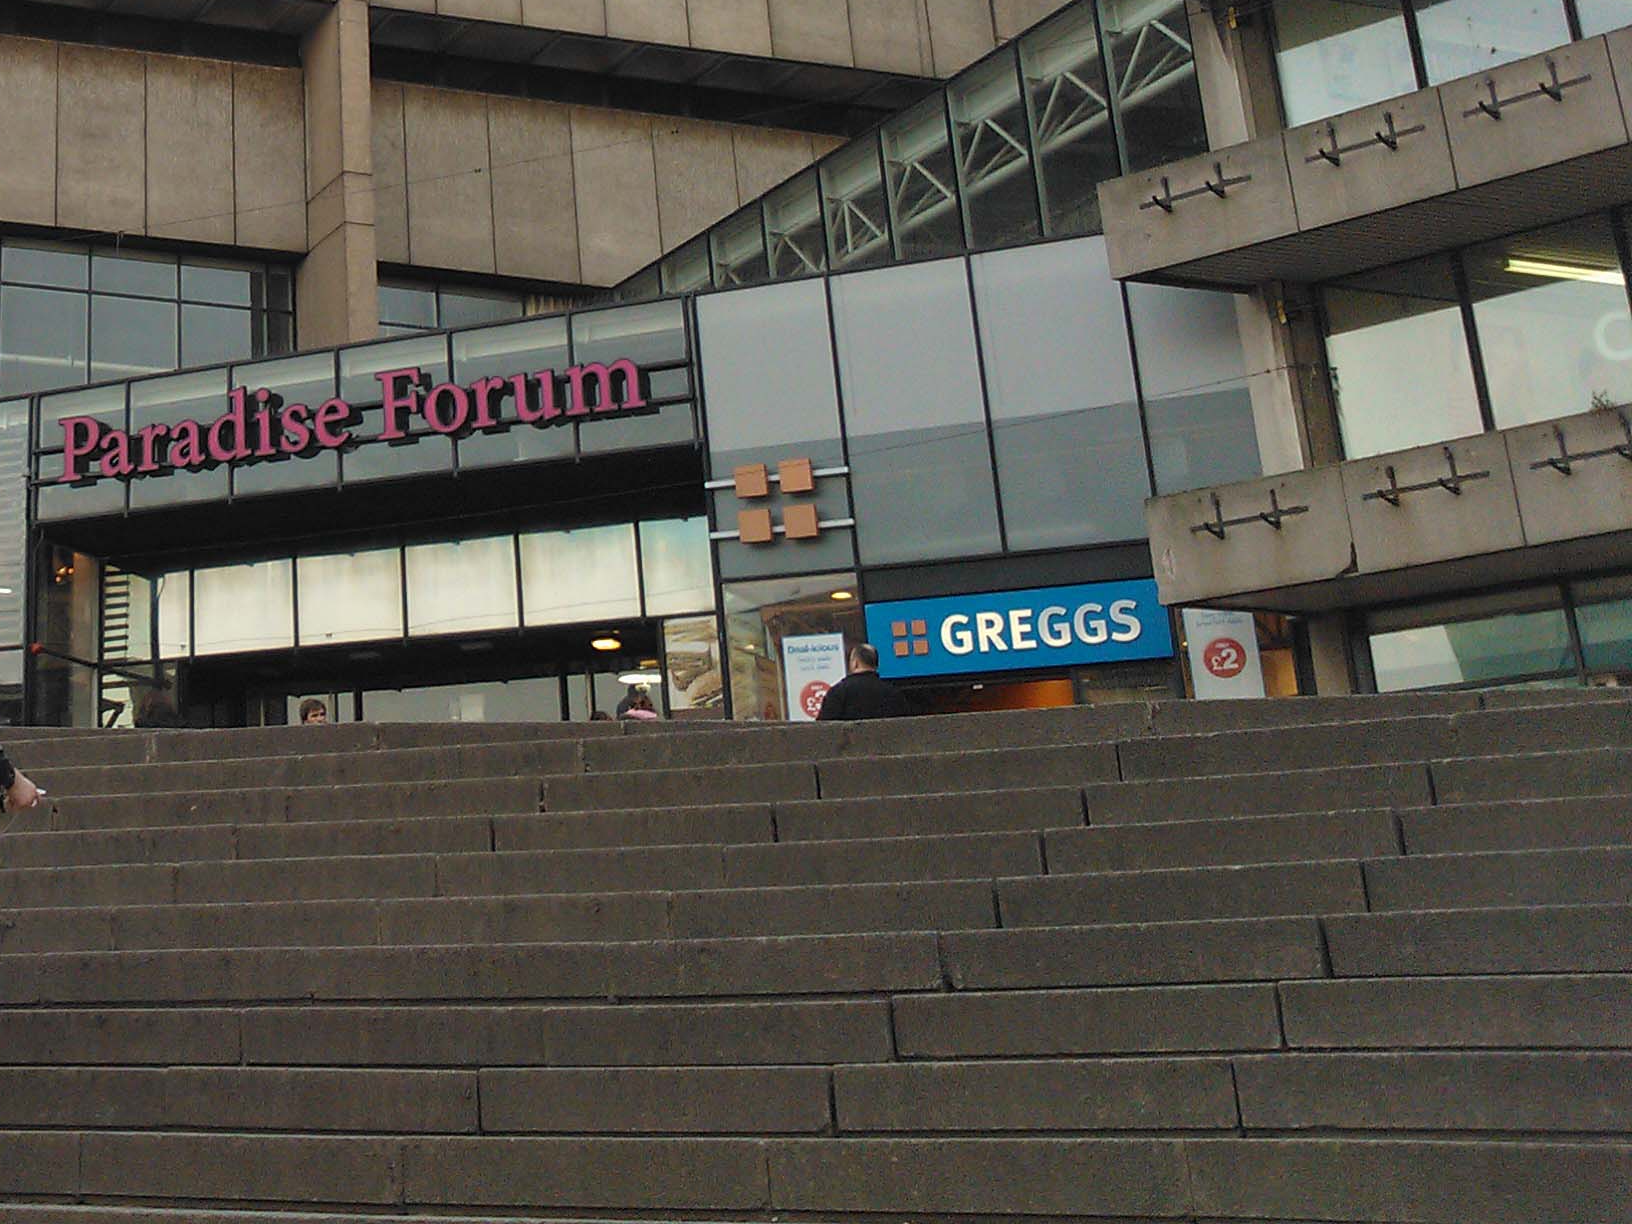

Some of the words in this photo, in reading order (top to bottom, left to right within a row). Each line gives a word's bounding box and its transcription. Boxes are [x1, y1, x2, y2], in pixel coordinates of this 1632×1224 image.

[58, 386, 352, 482] Paradise
[375, 358, 647, 440] Forum
[940, 599, 1142, 656] GREGGS
[1211, 647, 1239, 671] £2
